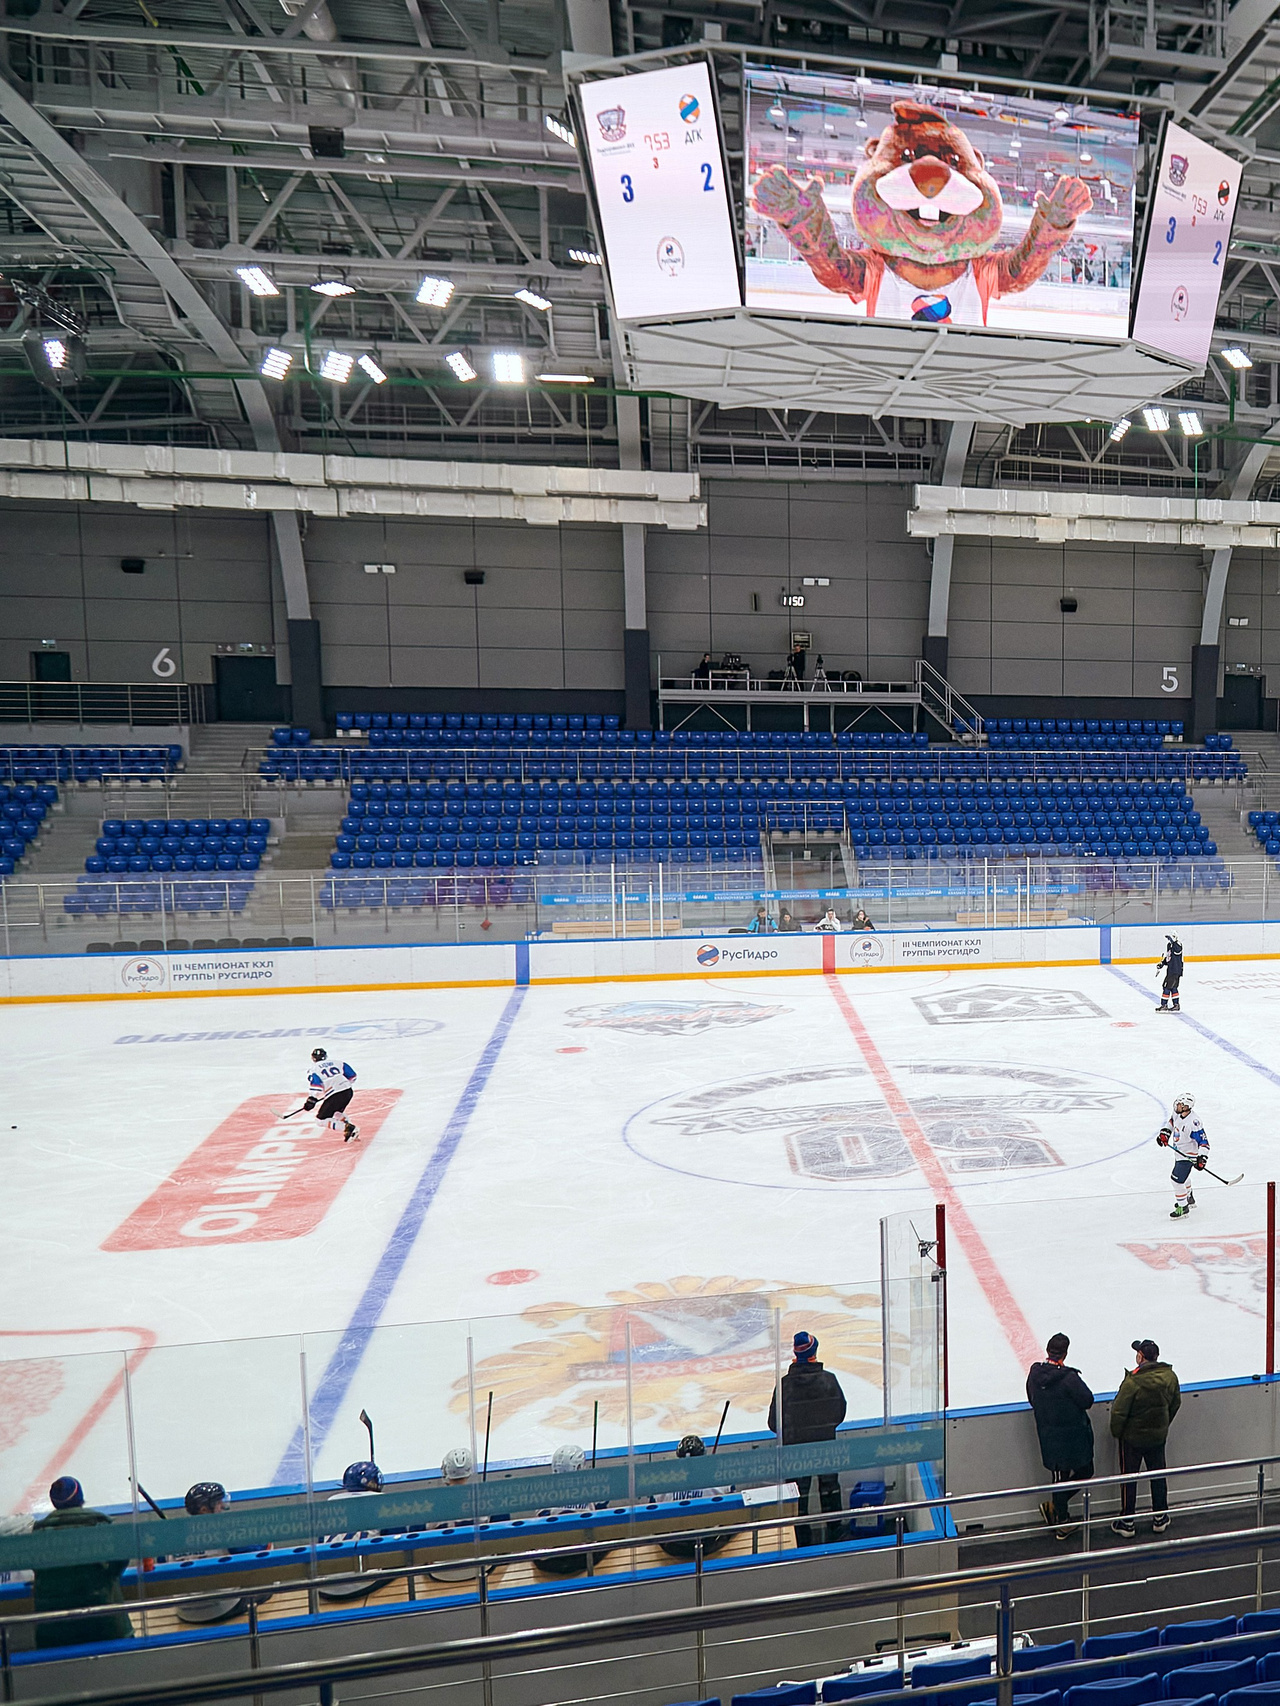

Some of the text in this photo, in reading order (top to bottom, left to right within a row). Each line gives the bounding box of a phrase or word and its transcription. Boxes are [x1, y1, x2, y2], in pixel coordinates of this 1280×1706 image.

[652, 157, 659, 169] 3
[620, 174, 634, 202] 3
[701, 163, 714, 192] 2
[1166, 216, 1176, 244] 3
[1212, 240, 1222, 266] 2
[151, 647, 176, 677] 6
[1160, 666, 1179, 692] 5
[721, 948, 778, 962] РусГидро
[902, 948, 980, 958] ГРУППЫ РУСГИДРО
[912, 940, 964, 948] ЧЕМПИОНАТ
[173, 971, 273, 982] ГРУППЫ РУСГИДРО
[184, 962, 249, 971] ЧЕМПИОНАТ
[252, 960, 274, 968] КХЛ
[783, 1107, 1066, 1181] 50
